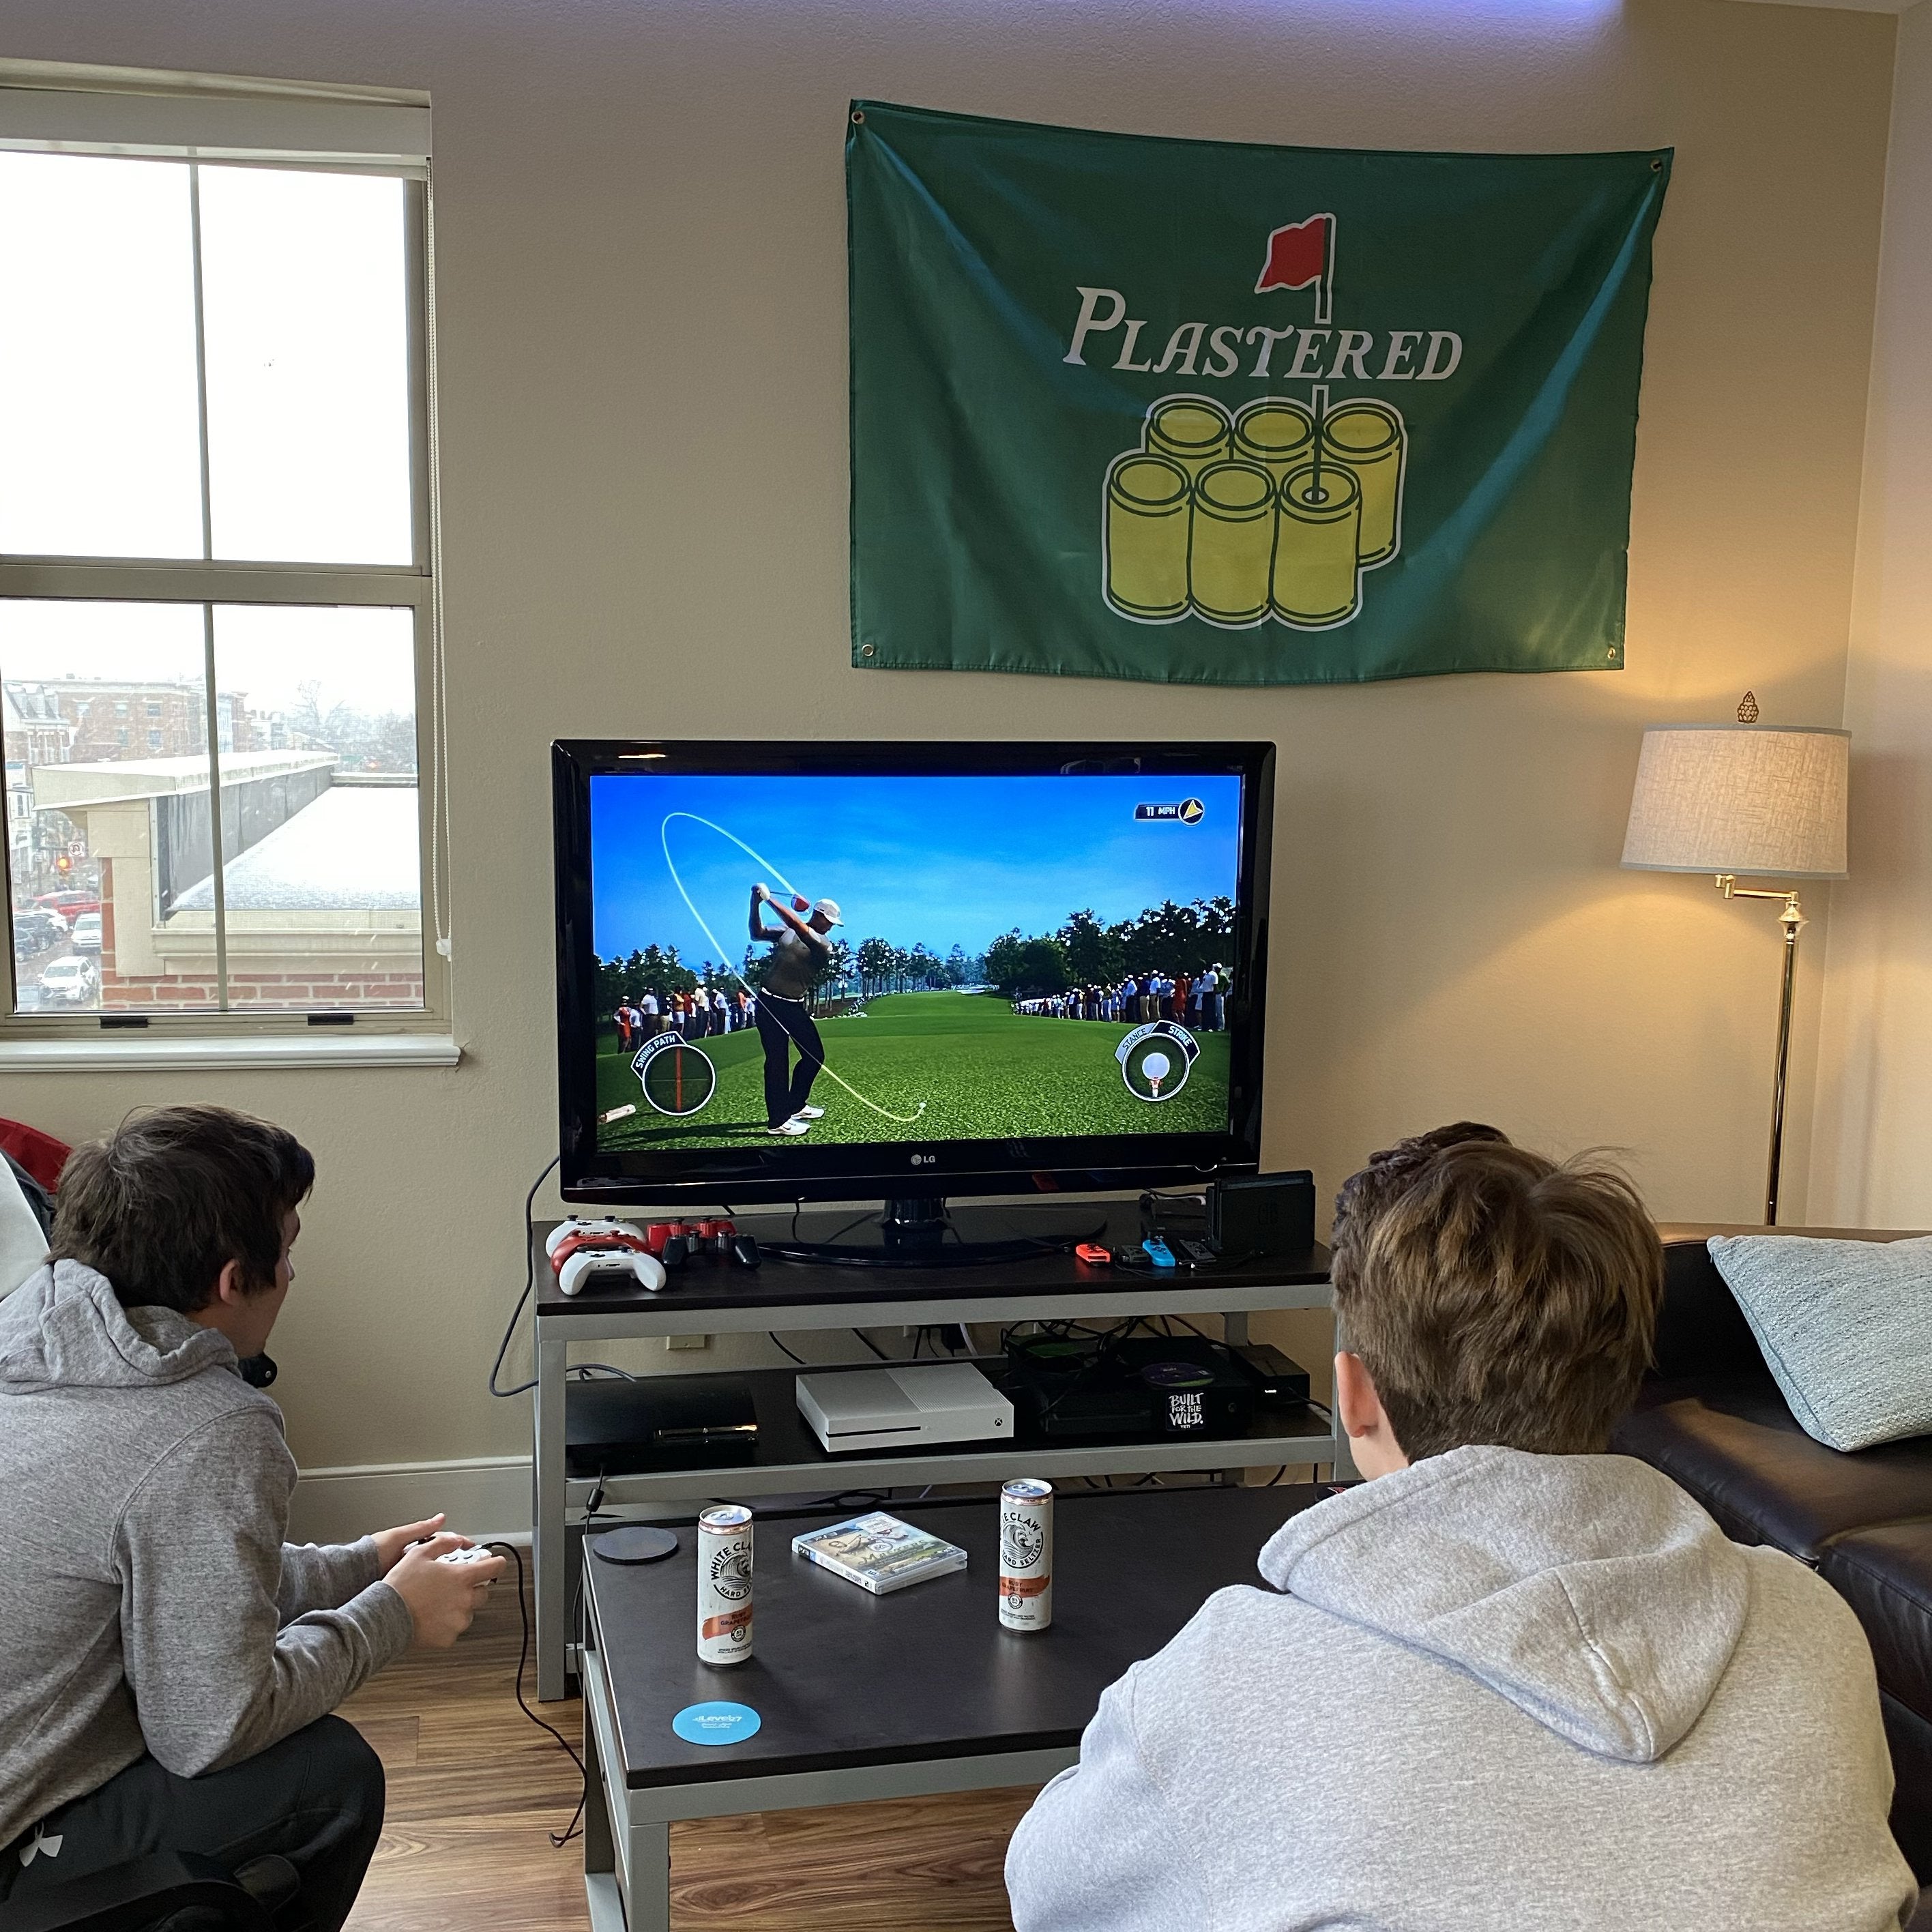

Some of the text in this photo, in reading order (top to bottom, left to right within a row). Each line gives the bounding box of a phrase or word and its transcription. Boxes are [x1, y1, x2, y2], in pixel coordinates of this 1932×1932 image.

[1062, 286, 1463, 381] PLASTERED
[1146, 806, 1175, 817] 11 MPH
[1122, 1027, 1147, 1049] STANCE
[1168, 1025, 1192, 1047] STRIKE
[635, 1034, 676, 1069] SWING PATH
[923, 1155, 935, 1163] LG
[1168, 1392, 1205, 1407] BUILT
[1169, 1405, 1187, 1414] FOR
[1010, 1512, 1041, 1532] CLAW
[710, 1541, 752, 1581] WHITE CLA
[1019, 1538, 1042, 1566] SELTZER
[720, 1585, 742, 1597] HARD
